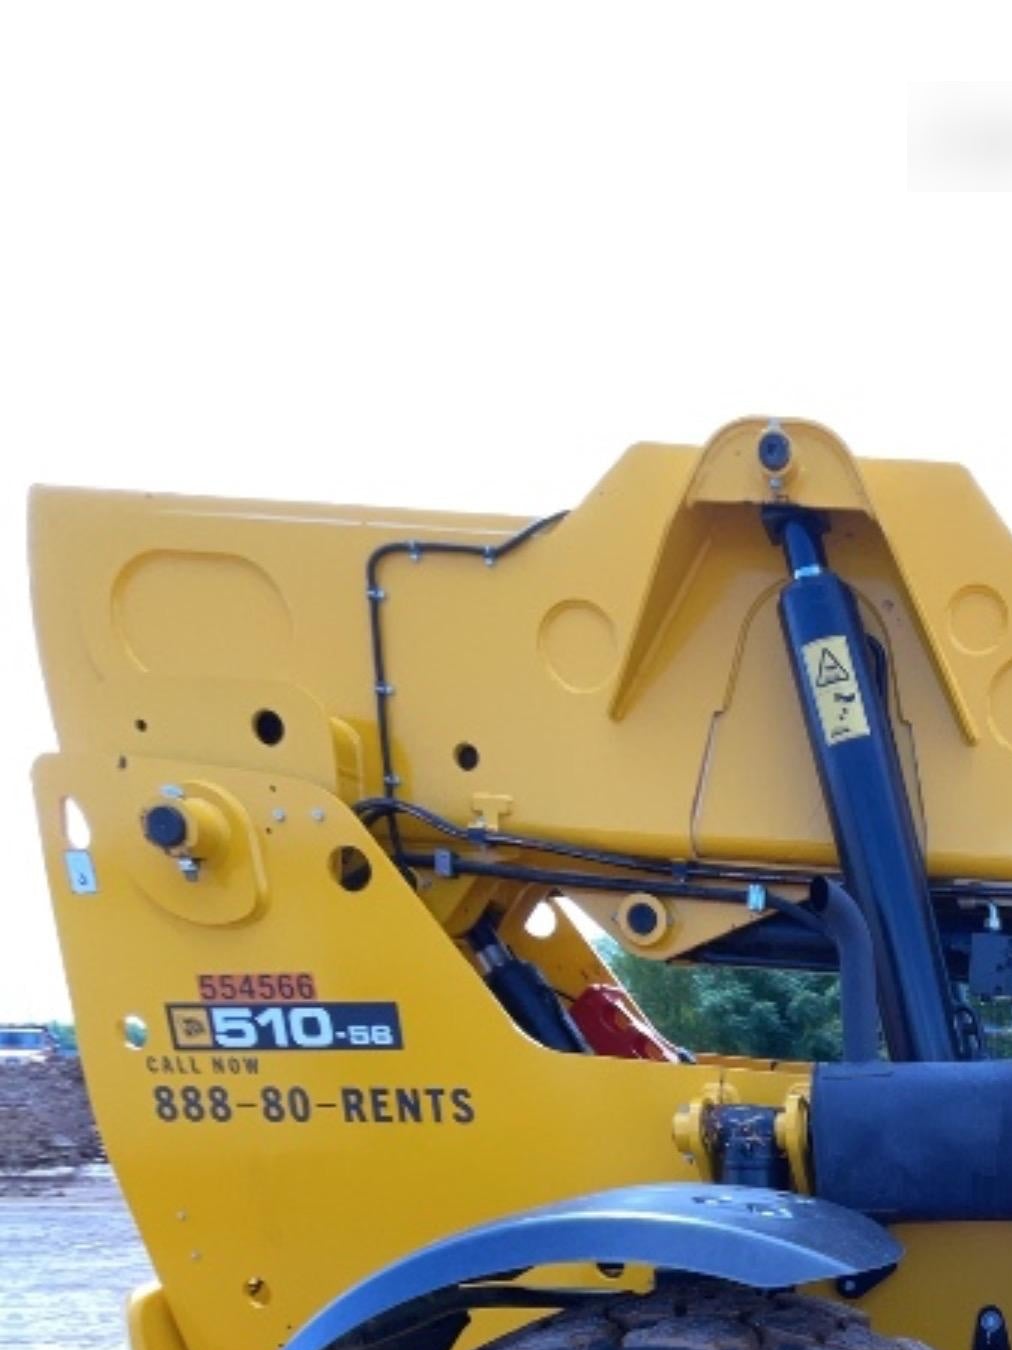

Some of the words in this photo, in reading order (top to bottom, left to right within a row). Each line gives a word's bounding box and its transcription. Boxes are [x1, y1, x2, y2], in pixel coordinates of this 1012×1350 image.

[200, 973, 315, 1000] 554566
[146, 1056, 201, 1075] CALL
[212, 1056, 259, 1075] NOW
[154, 1084, 475, 1123] 888-80-RENTS
